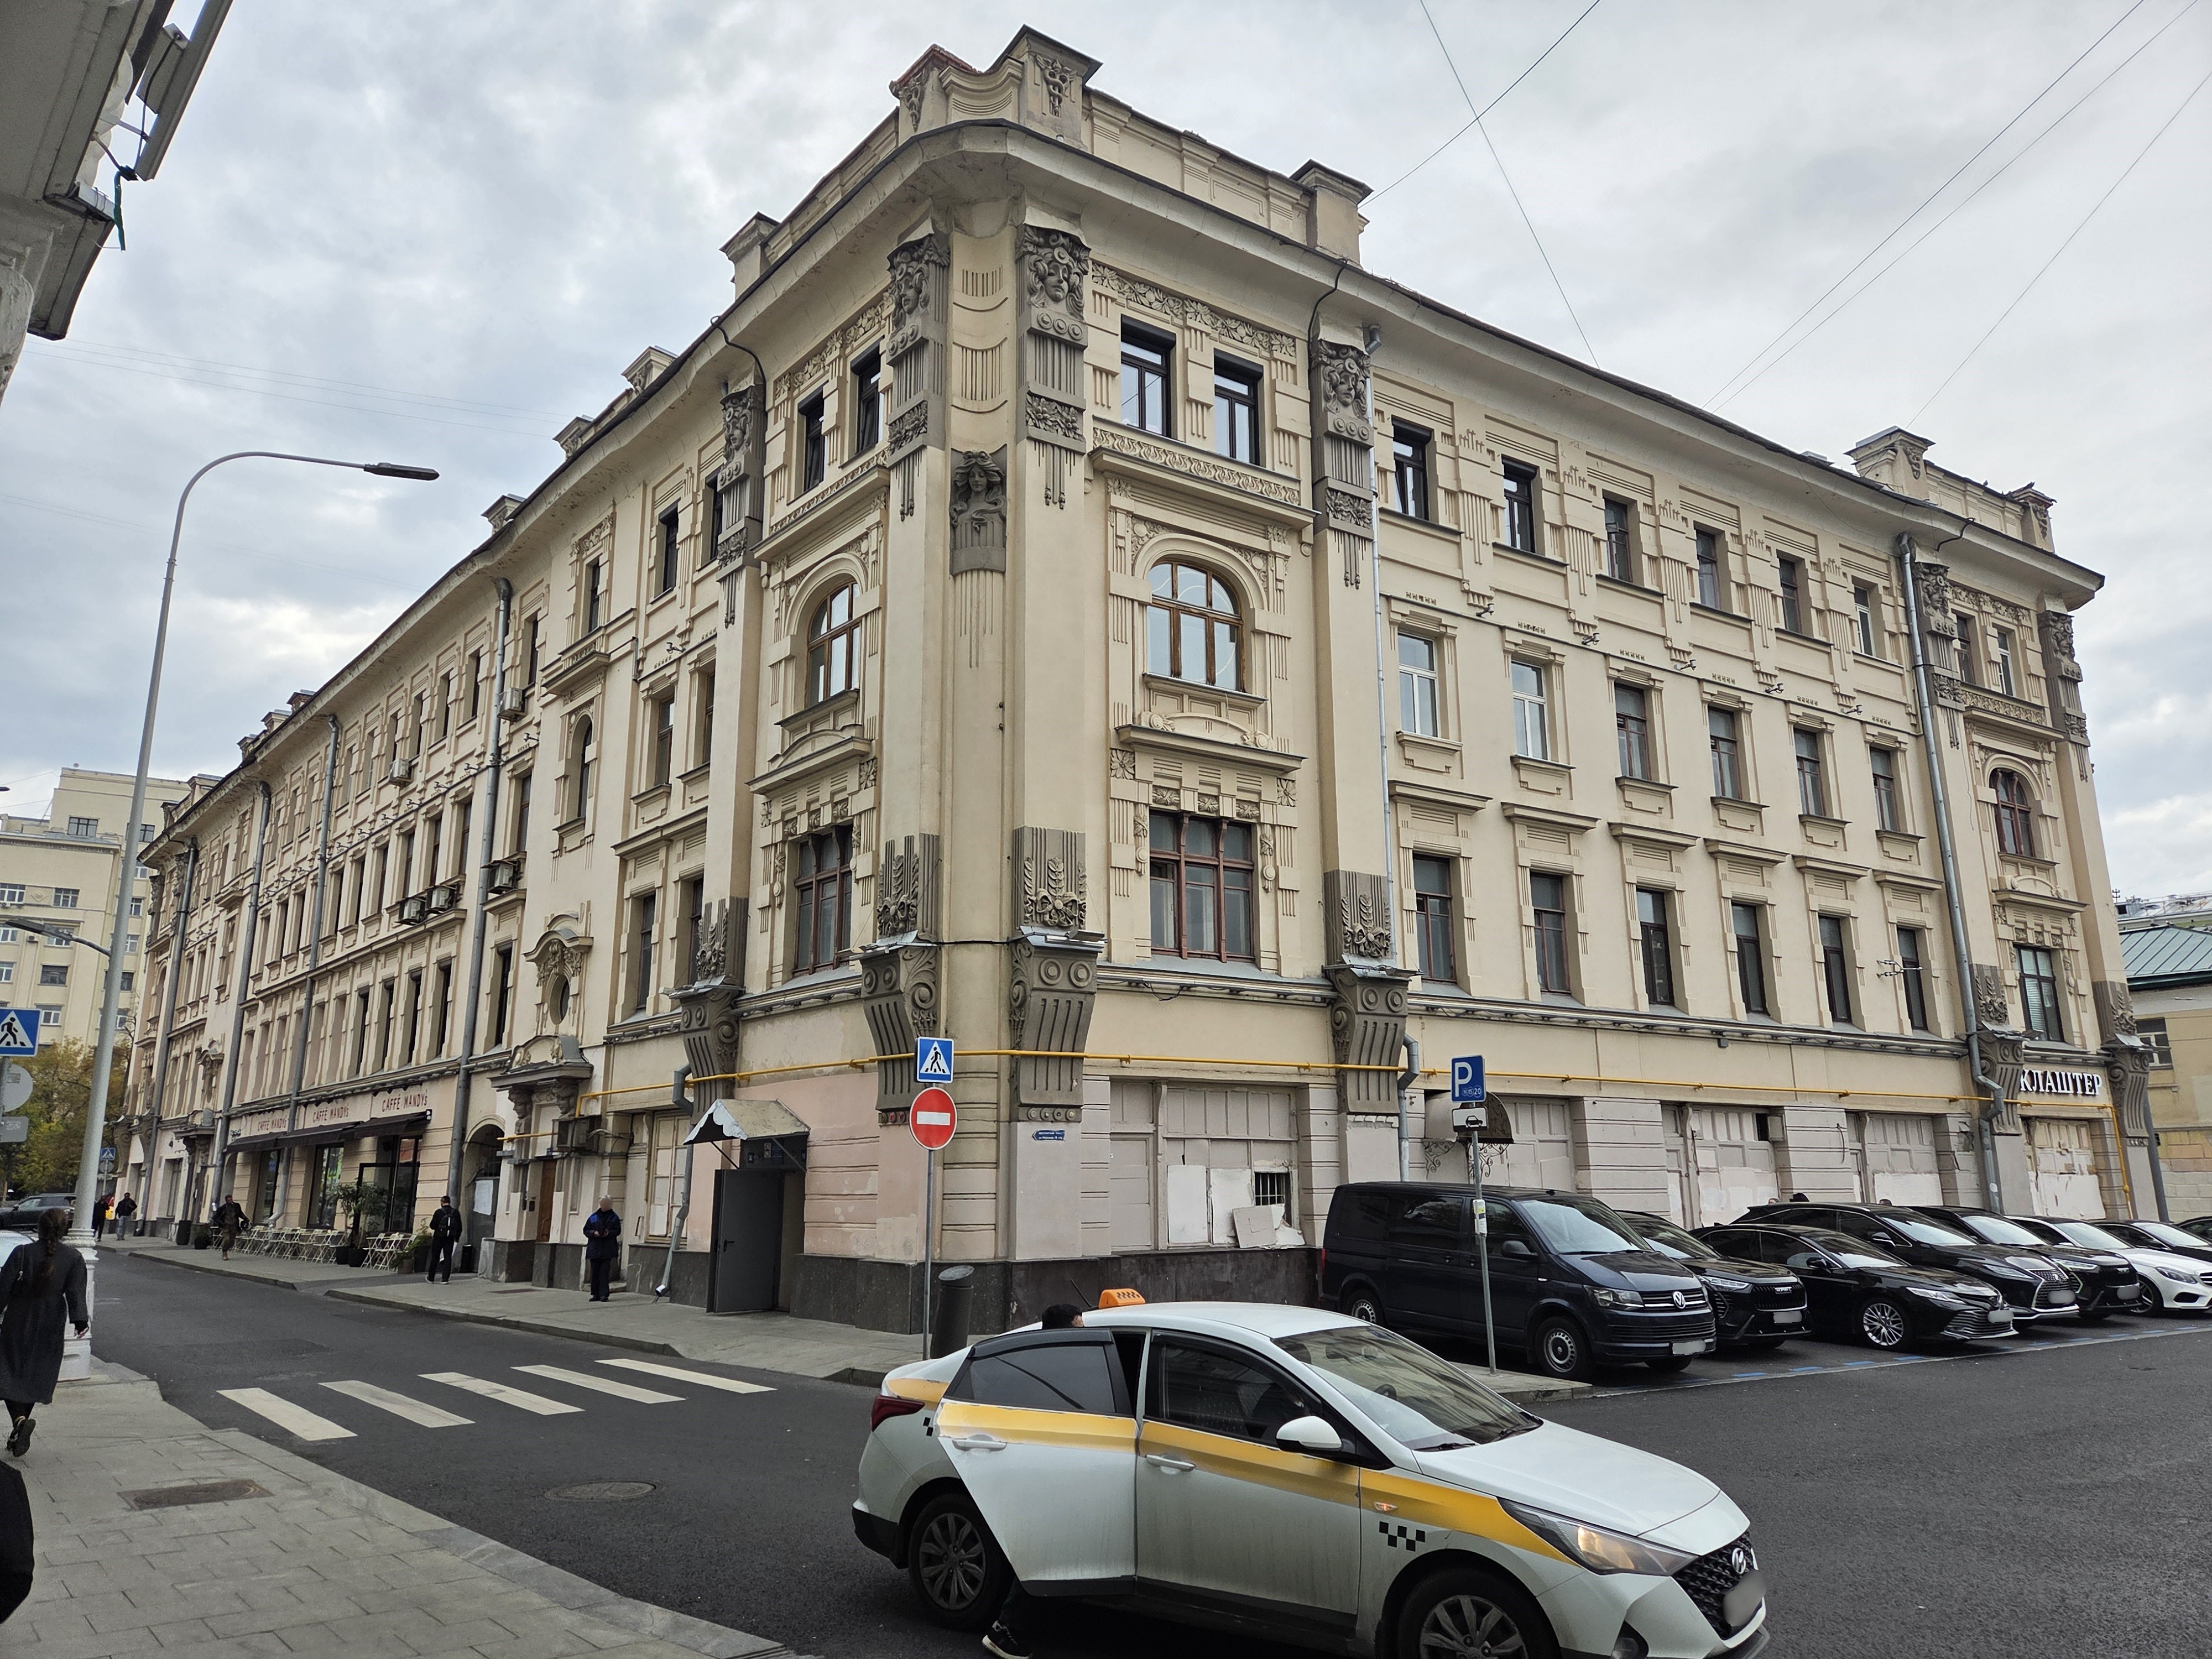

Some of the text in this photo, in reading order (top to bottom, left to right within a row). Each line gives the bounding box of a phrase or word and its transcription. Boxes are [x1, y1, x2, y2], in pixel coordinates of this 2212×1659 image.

[1455, 1062, 1472, 1097] P
[2020, 1069, 2102, 1095] КЛАШТЕР
[382, 1094, 401, 1112] CAFFÉ
